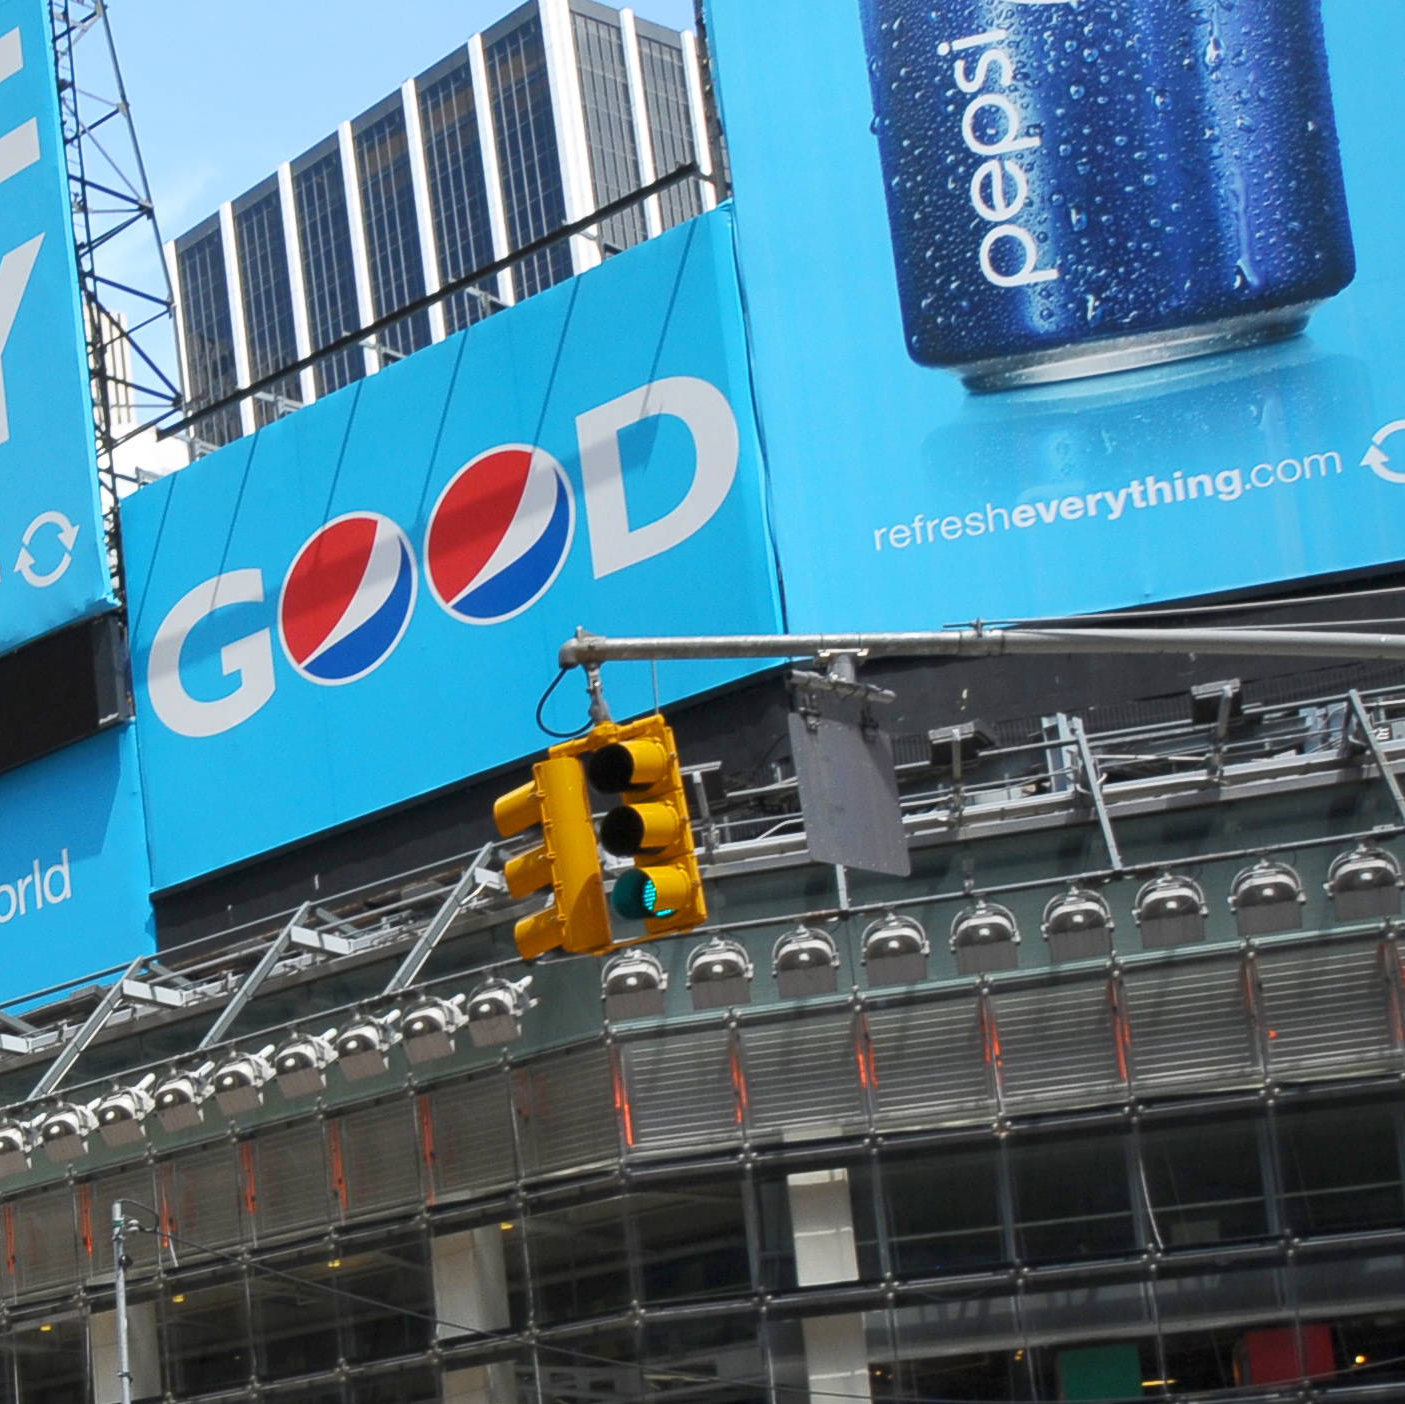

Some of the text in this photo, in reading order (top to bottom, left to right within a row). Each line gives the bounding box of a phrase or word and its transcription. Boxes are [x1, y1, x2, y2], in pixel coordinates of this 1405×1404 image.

[937, 28, 1060, 287] pepsi
[147, 376, 740, 738] GOOD
[873, 447, 1343, 551] refresheverything.com
